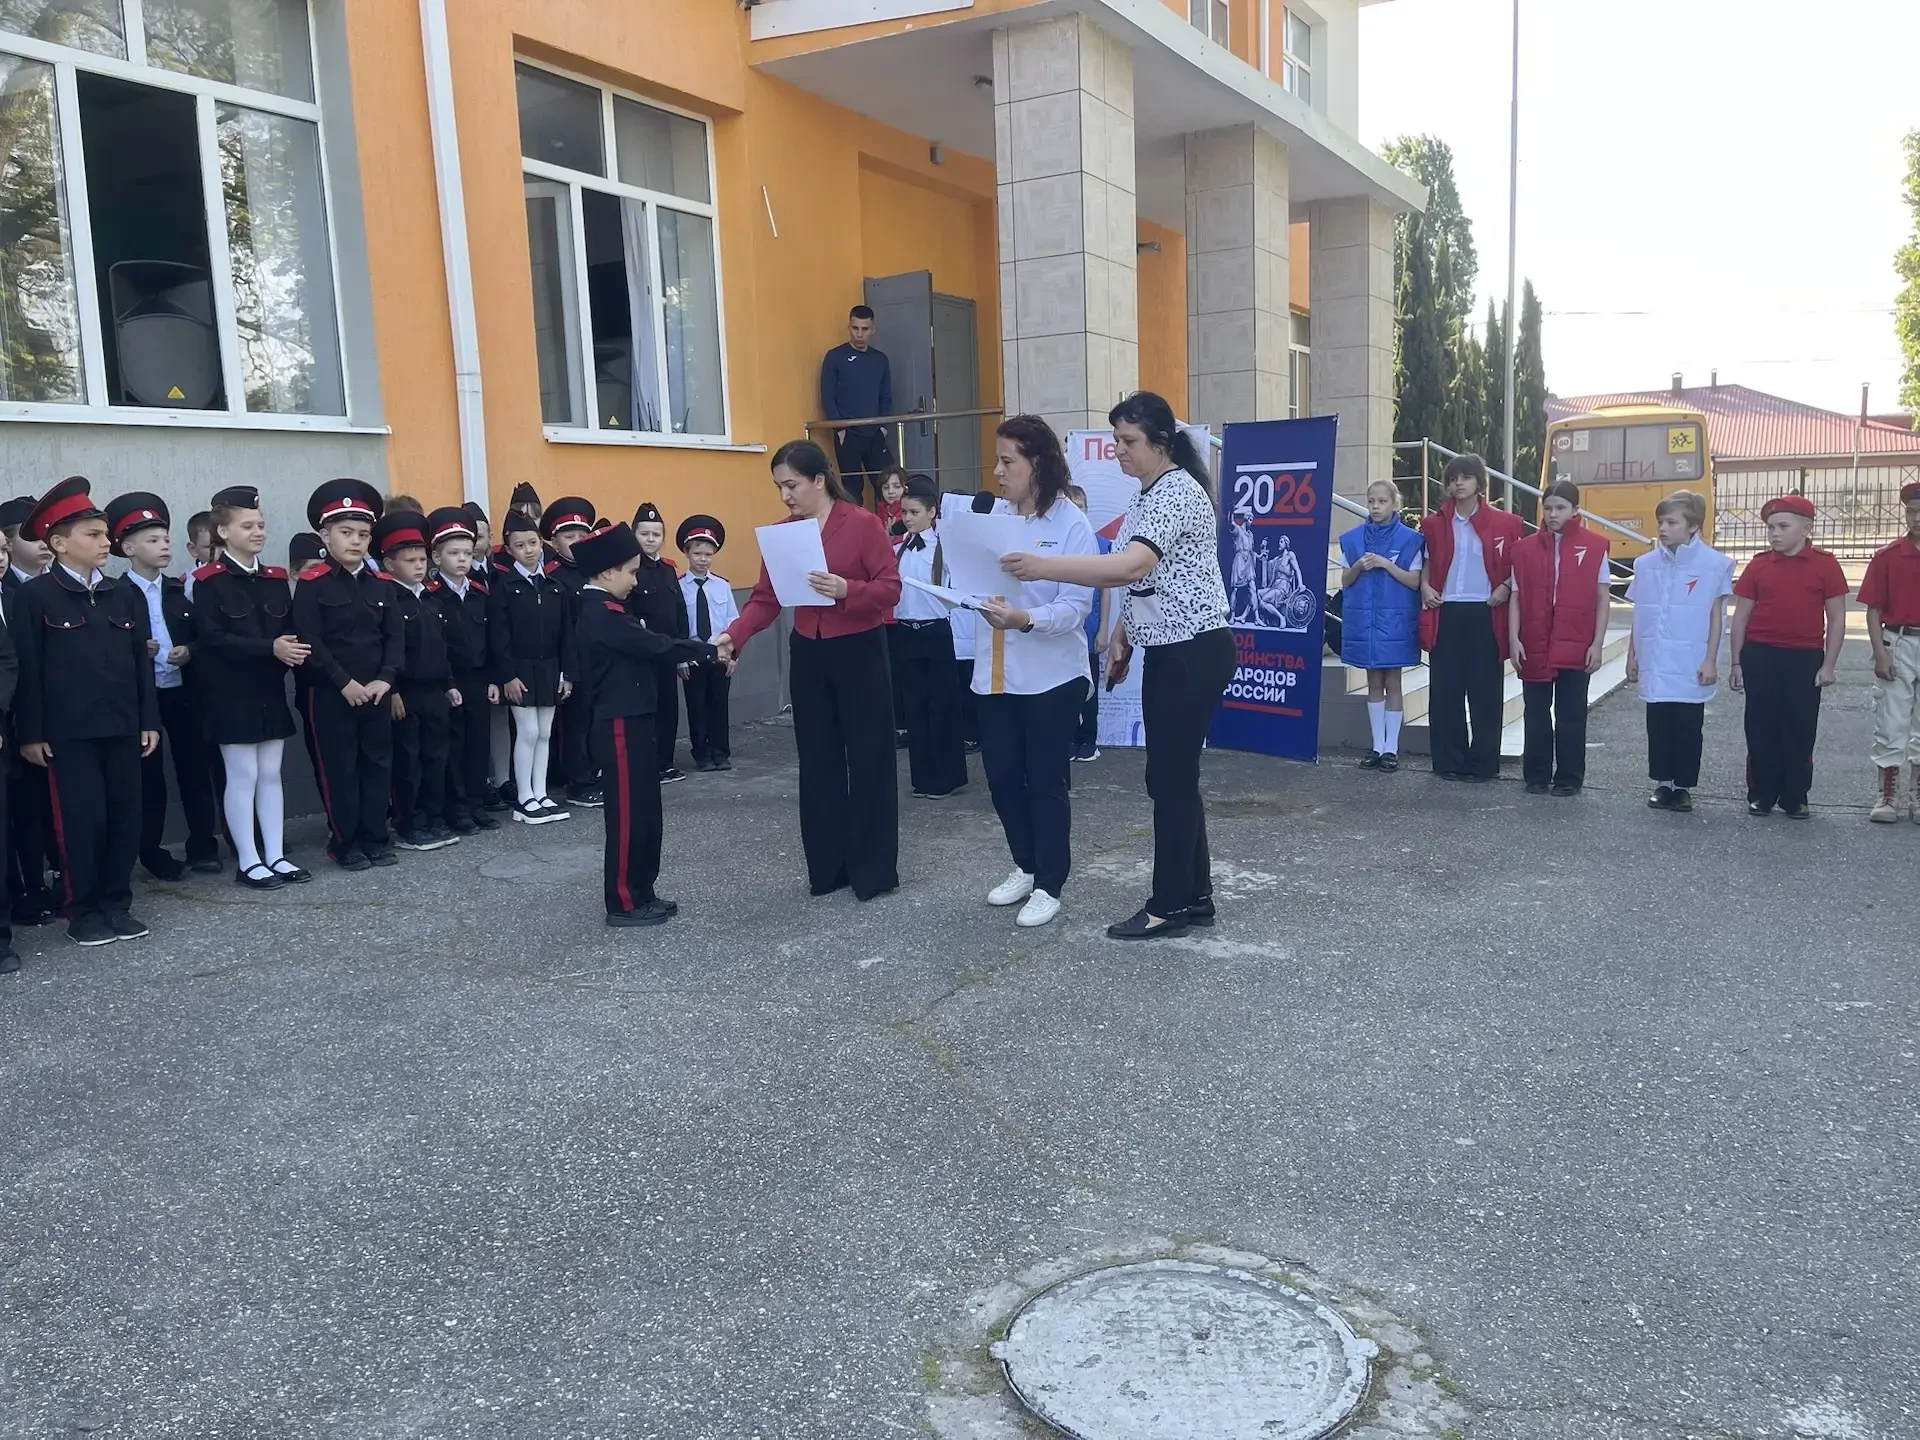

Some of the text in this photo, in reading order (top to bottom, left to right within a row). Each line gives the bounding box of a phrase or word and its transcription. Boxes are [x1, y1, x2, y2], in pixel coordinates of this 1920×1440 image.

[1085, 438, 1117, 460] Пе
[1559, 439, 1569, 447] 60
[1592, 460, 1655, 480] ДЕТИ
[1234, 473, 1316, 514] 2026
[1234, 633, 1255, 650] ОД
[1236, 650, 1305, 669] ДИНСТВА
[1233, 667, 1297, 687] АРОДОВ
